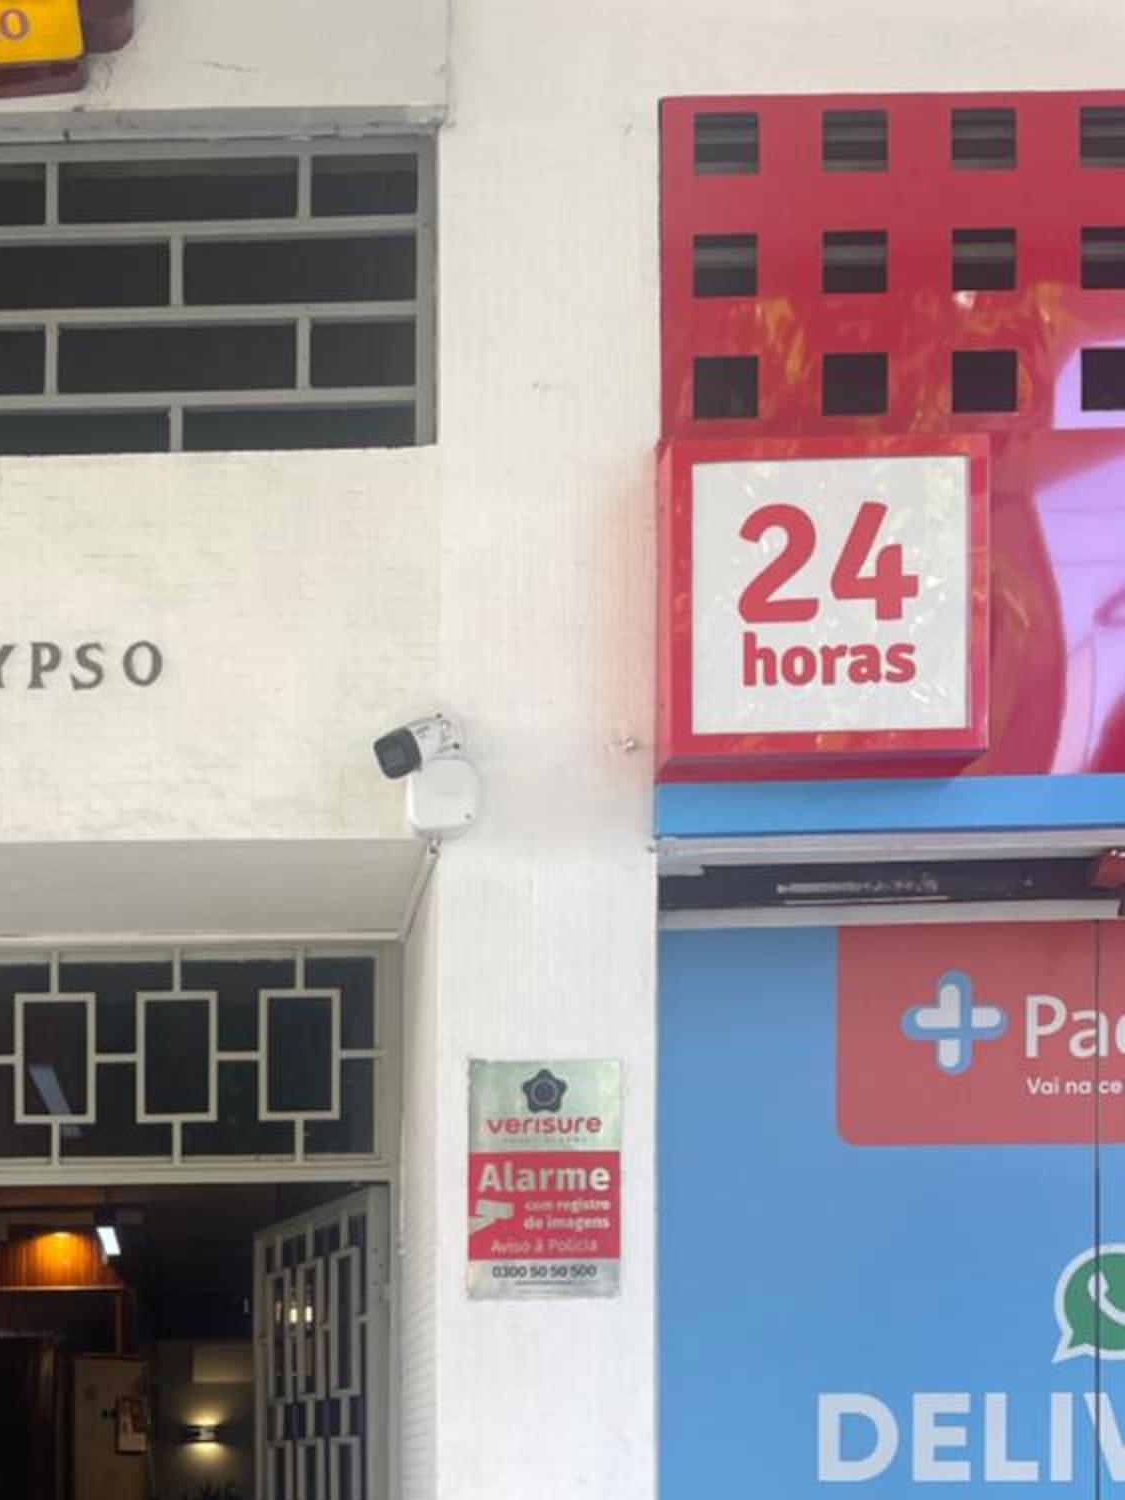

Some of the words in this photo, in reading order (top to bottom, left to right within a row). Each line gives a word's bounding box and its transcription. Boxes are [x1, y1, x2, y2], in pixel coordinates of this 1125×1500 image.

[737, 500, 919, 624] 24
[742, 631, 917, 687] horas
[1026, 1076, 1059, 1095] Vai
[1066, 1080, 1092, 1095] na
[487, 1116, 602, 1135] verisure
[479, 1162, 611, 1192] Alarme
